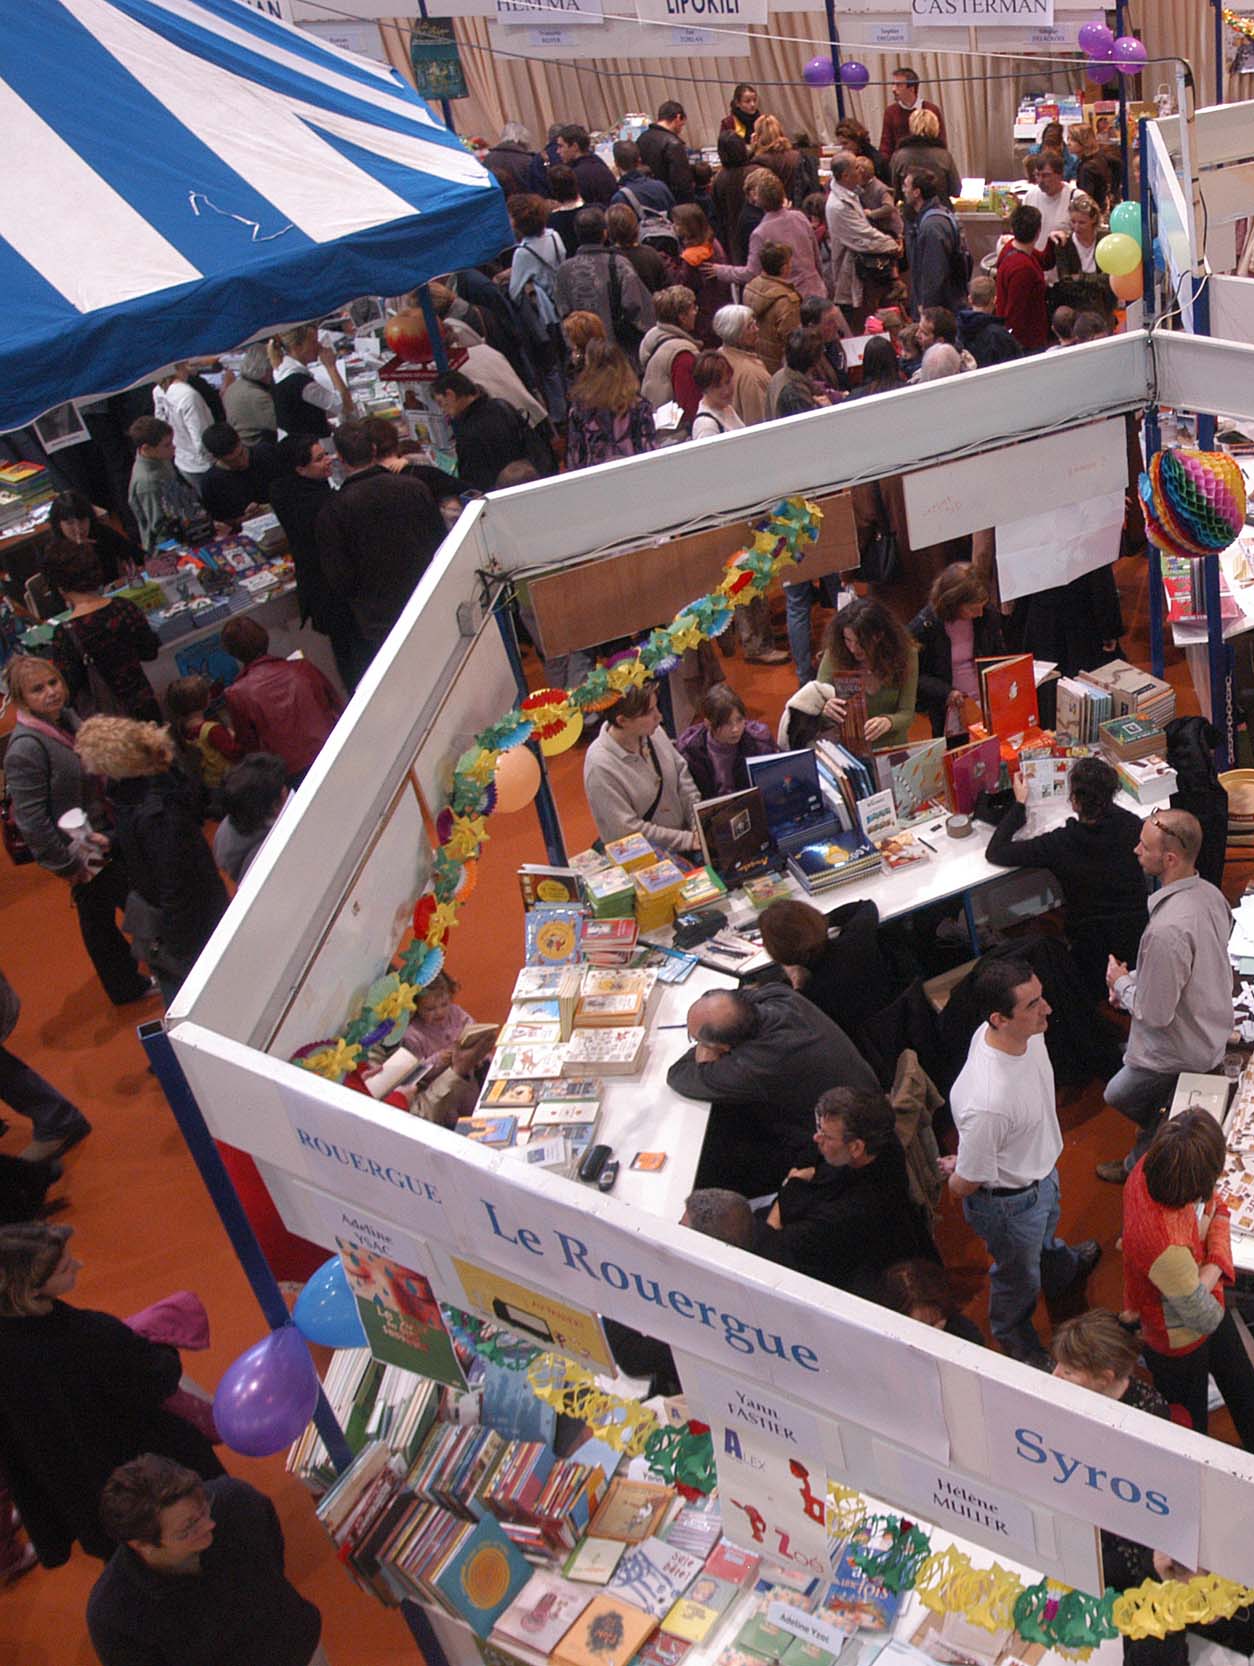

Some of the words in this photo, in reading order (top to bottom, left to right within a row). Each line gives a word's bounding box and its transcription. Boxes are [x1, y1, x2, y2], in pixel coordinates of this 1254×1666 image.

[913, 0, 1047, 15] CASTERMAN
[299, 1126, 442, 1204] ROUERGUE
[342, 1213, 393, 1244] Adeline
[481, 1198, 544, 1257] Le
[553, 1230, 820, 1373] Rouergue
[728, 1402, 798, 1444] FASTIER
[736, 1390, 779, 1419] Yann
[1015, 1428, 1170, 1516] Syros
[933, 1493, 1009, 1536] MULLER
